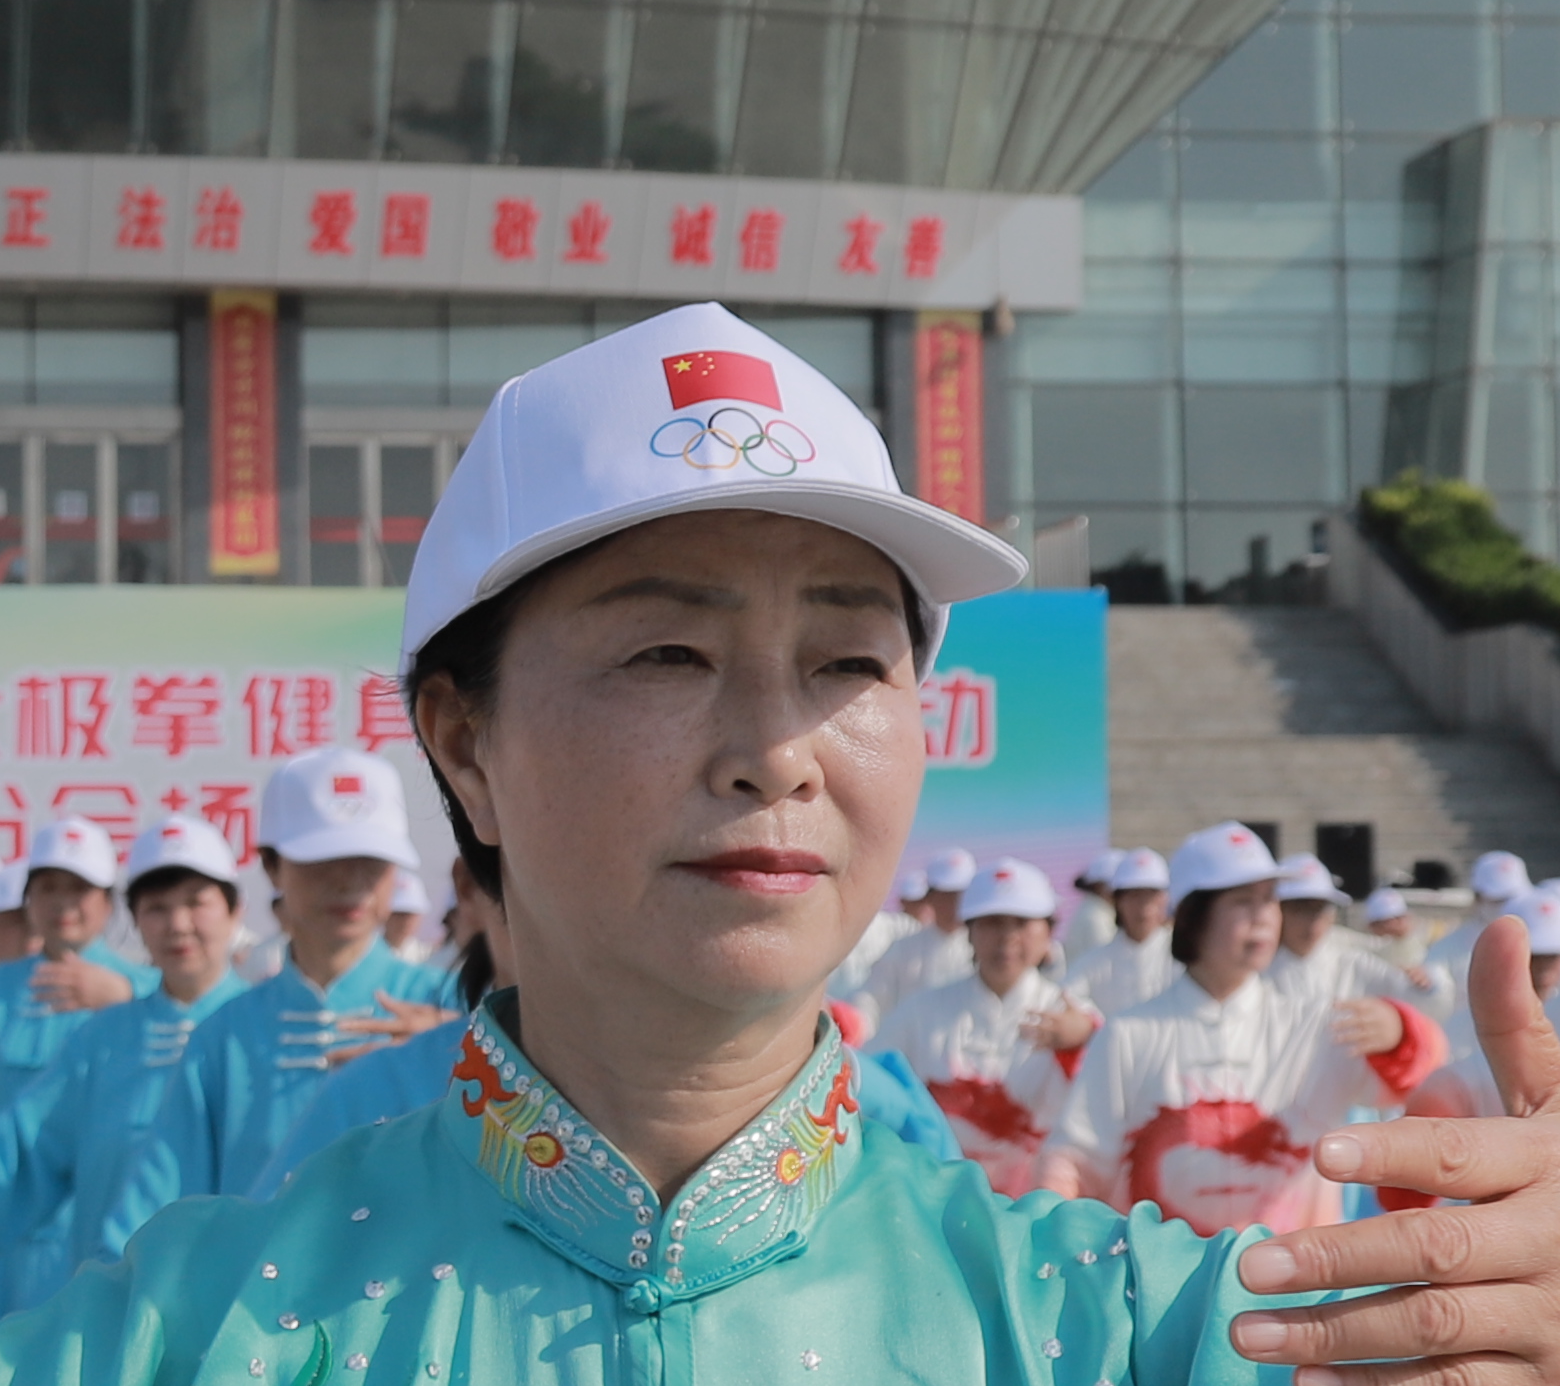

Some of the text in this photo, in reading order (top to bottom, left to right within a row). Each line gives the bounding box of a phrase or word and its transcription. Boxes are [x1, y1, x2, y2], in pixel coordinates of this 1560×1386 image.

[117, 187, 243, 251] 法治
[308, 189, 431, 257] 爱国
[490, 197, 611, 263] 敬业
[669, 203, 784, 271] 诚信
[838, 213, 944, 278] 友善
